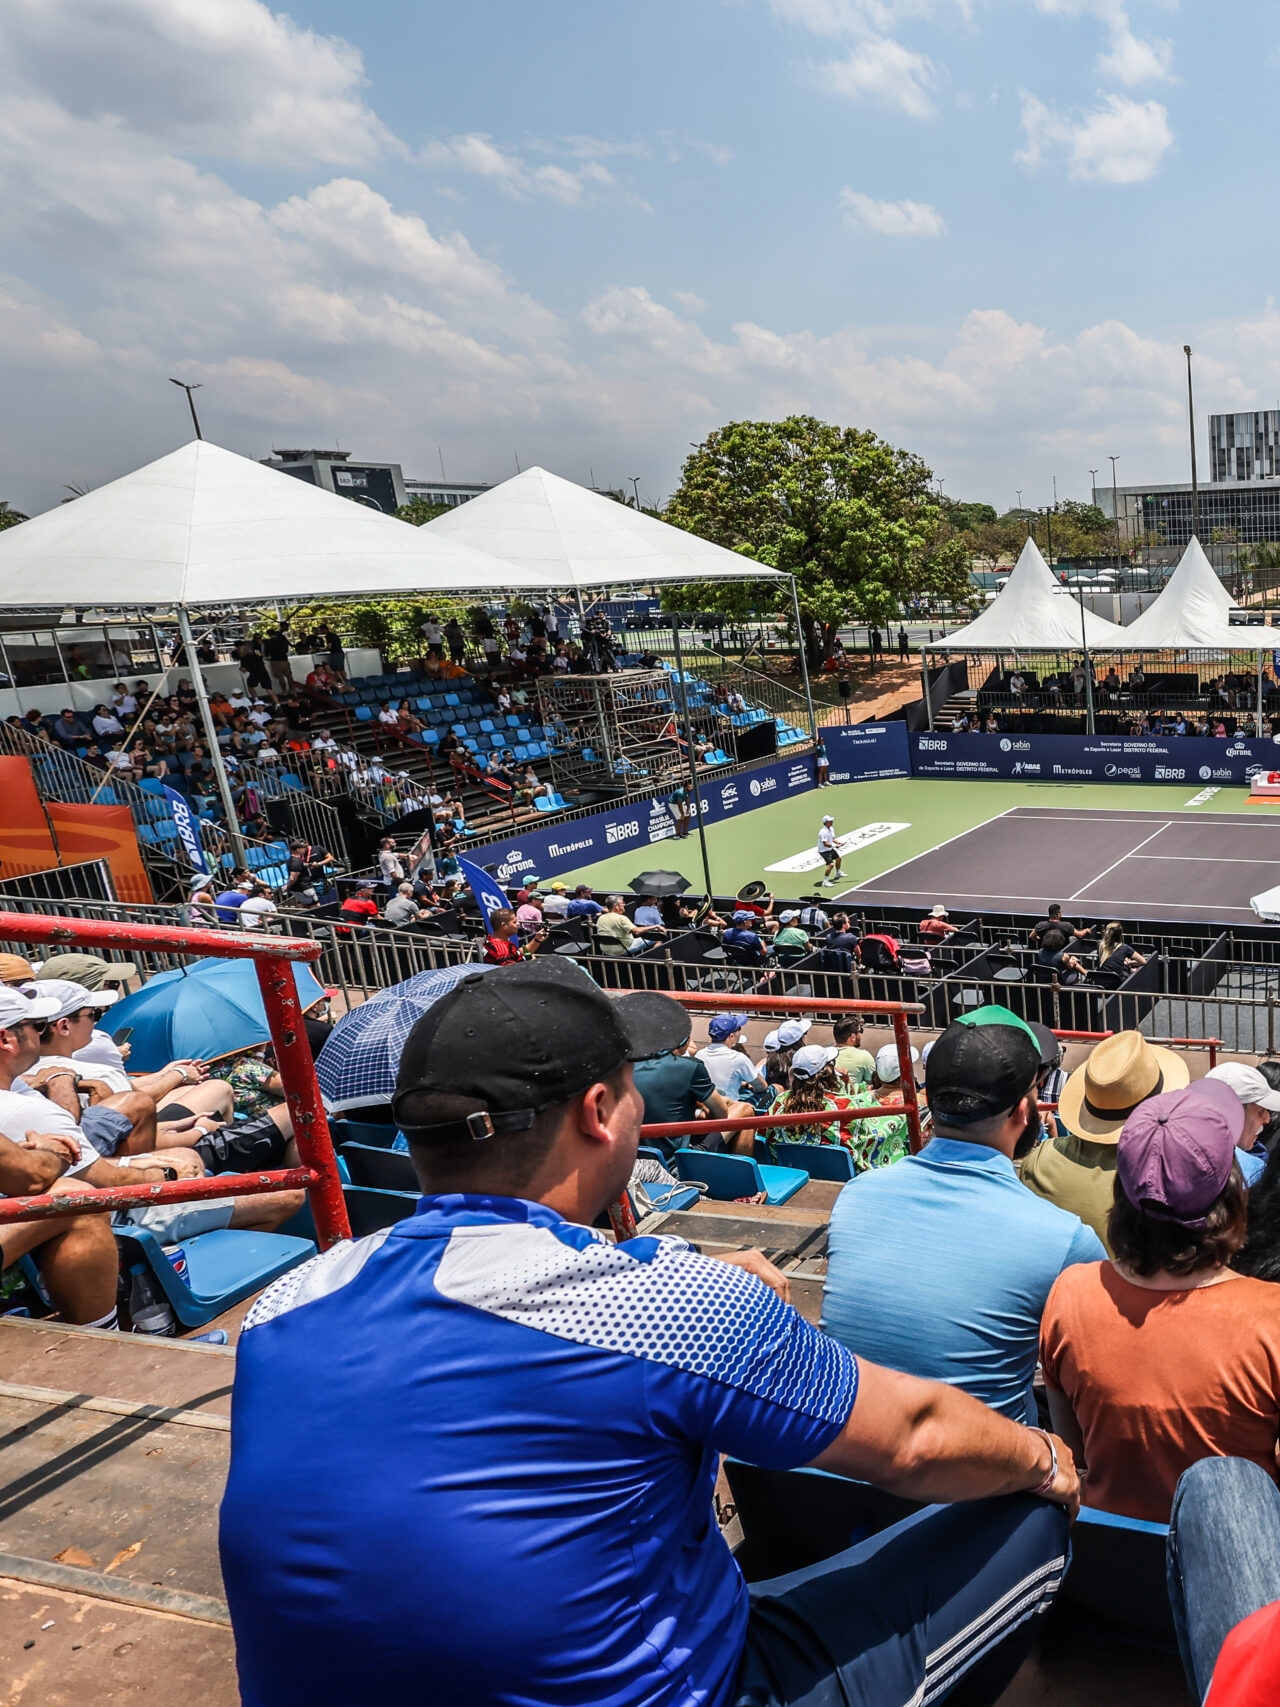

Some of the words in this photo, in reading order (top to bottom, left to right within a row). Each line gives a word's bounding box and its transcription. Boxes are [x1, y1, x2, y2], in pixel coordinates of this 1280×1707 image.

[929, 740, 947, 750] BRB
[1012, 740, 1030, 749] sabin
[1226, 748, 1252, 757] Corona
[1053, 765, 1092, 775] METRÓPOLES
[1118, 766, 1140, 775] pepsi
[1165, 768, 1185, 779] BRB
[1213, 768, 1231, 776] sabin
[761, 778, 776, 789] sabin
[721, 787, 738, 798] Sesc
[690, 799, 709, 816] BB
[172, 800, 194, 843] BRB
[618, 821, 639, 841] BRB
[548, 839, 593, 858] METRÓPOLES
[497, 859, 536, 878] Corona
